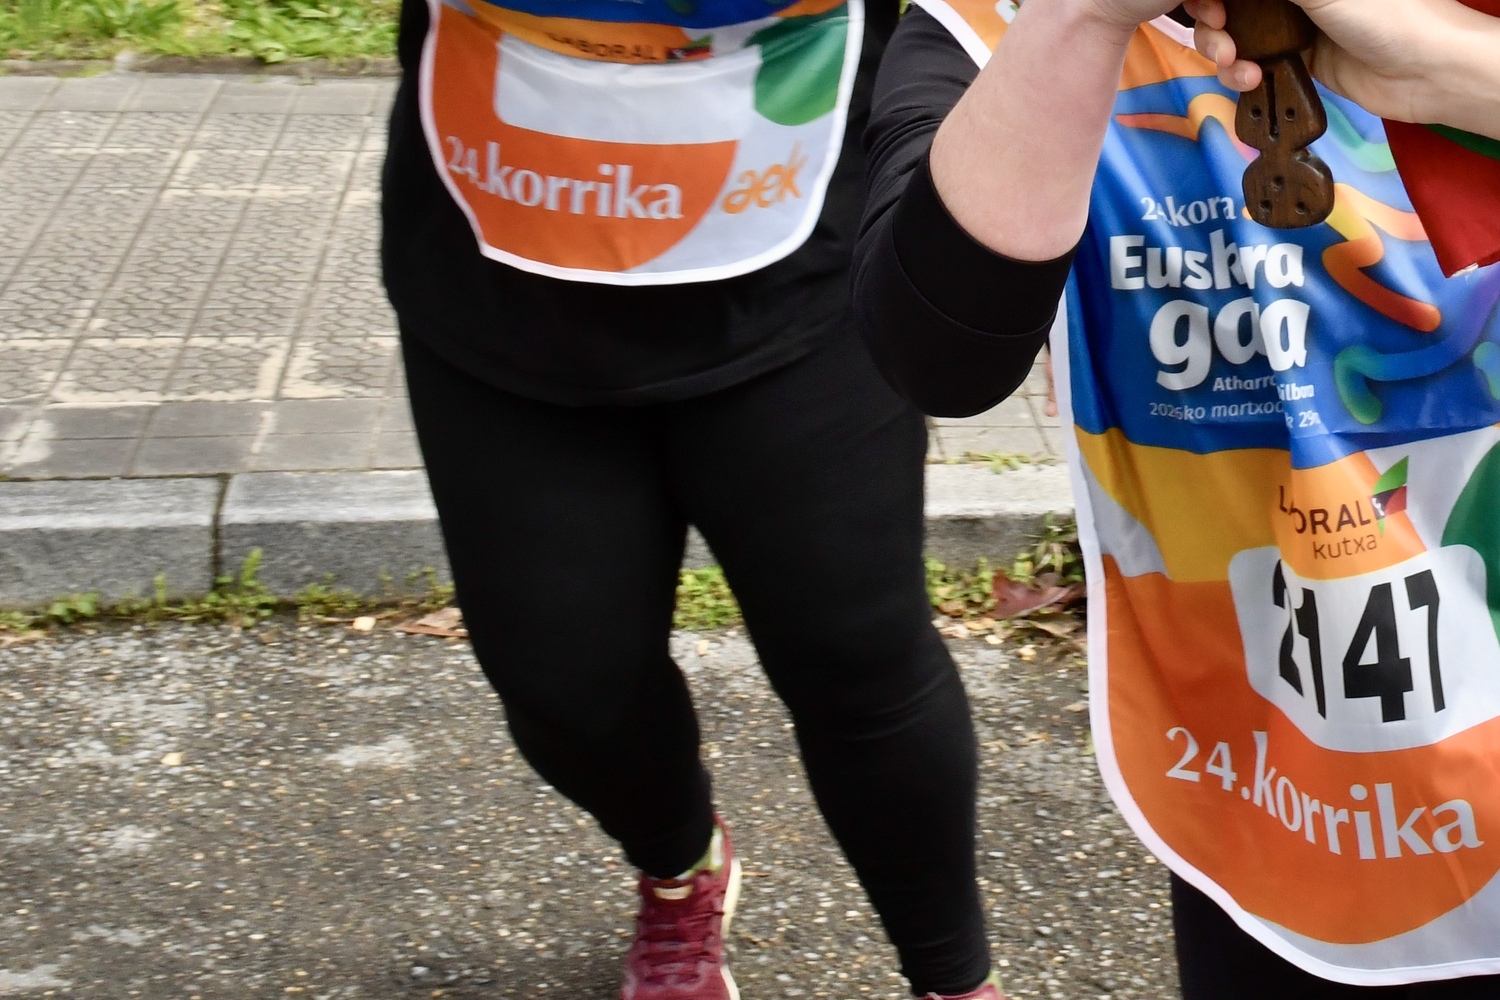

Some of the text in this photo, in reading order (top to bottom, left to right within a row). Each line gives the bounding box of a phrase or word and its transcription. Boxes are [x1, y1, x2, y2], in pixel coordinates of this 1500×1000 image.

[446, 135, 809, 220] 24.korrika aek
[1312, 533, 1378, 560] kutxa
[1165, 726, 1484, 860] 24.korrika
